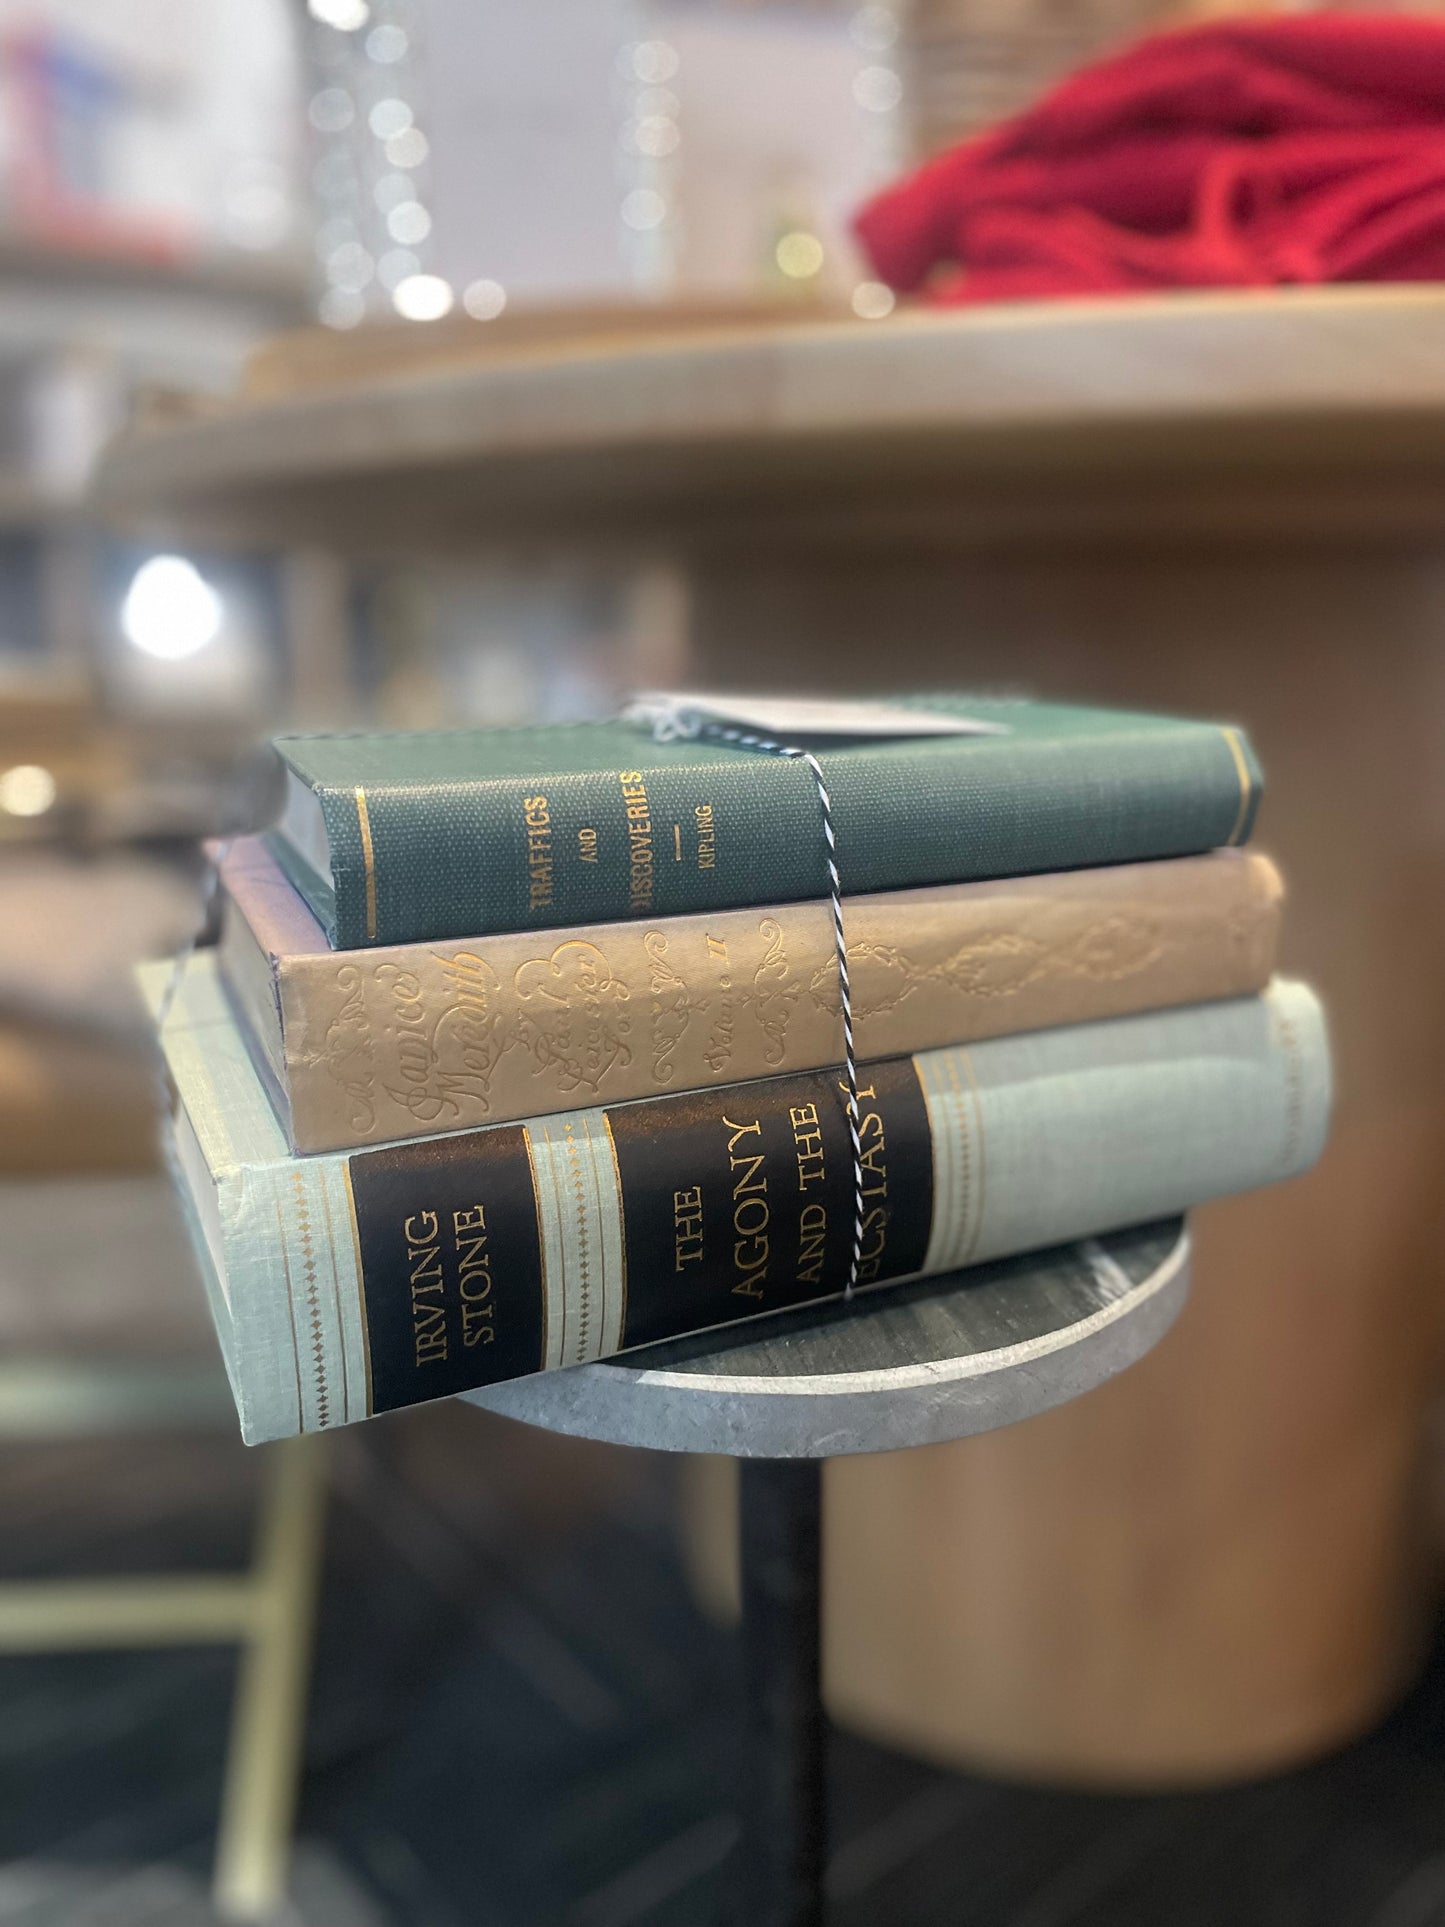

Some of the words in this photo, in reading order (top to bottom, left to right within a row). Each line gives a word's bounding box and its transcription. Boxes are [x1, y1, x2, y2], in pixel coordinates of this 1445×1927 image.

[524, 795, 553, 909] TRAFFICS
[578, 828, 598, 863] AND
[695, 804, 715, 869] KIPLING
[706, 932, 730, 966] II
[374, 963, 459, 1121] Janice
[430, 951, 501, 1112] Meredith
[703, 975, 732, 1072] Volume
[790, 1102, 826, 1191] THE
[673, 1185, 704, 1272] THE
[722, 1114, 771, 1301] AGONY
[796, 1203, 828, 1284] AND
[404, 1209, 449, 1367] IRVING
[454, 1204, 495, 1349] STONE
